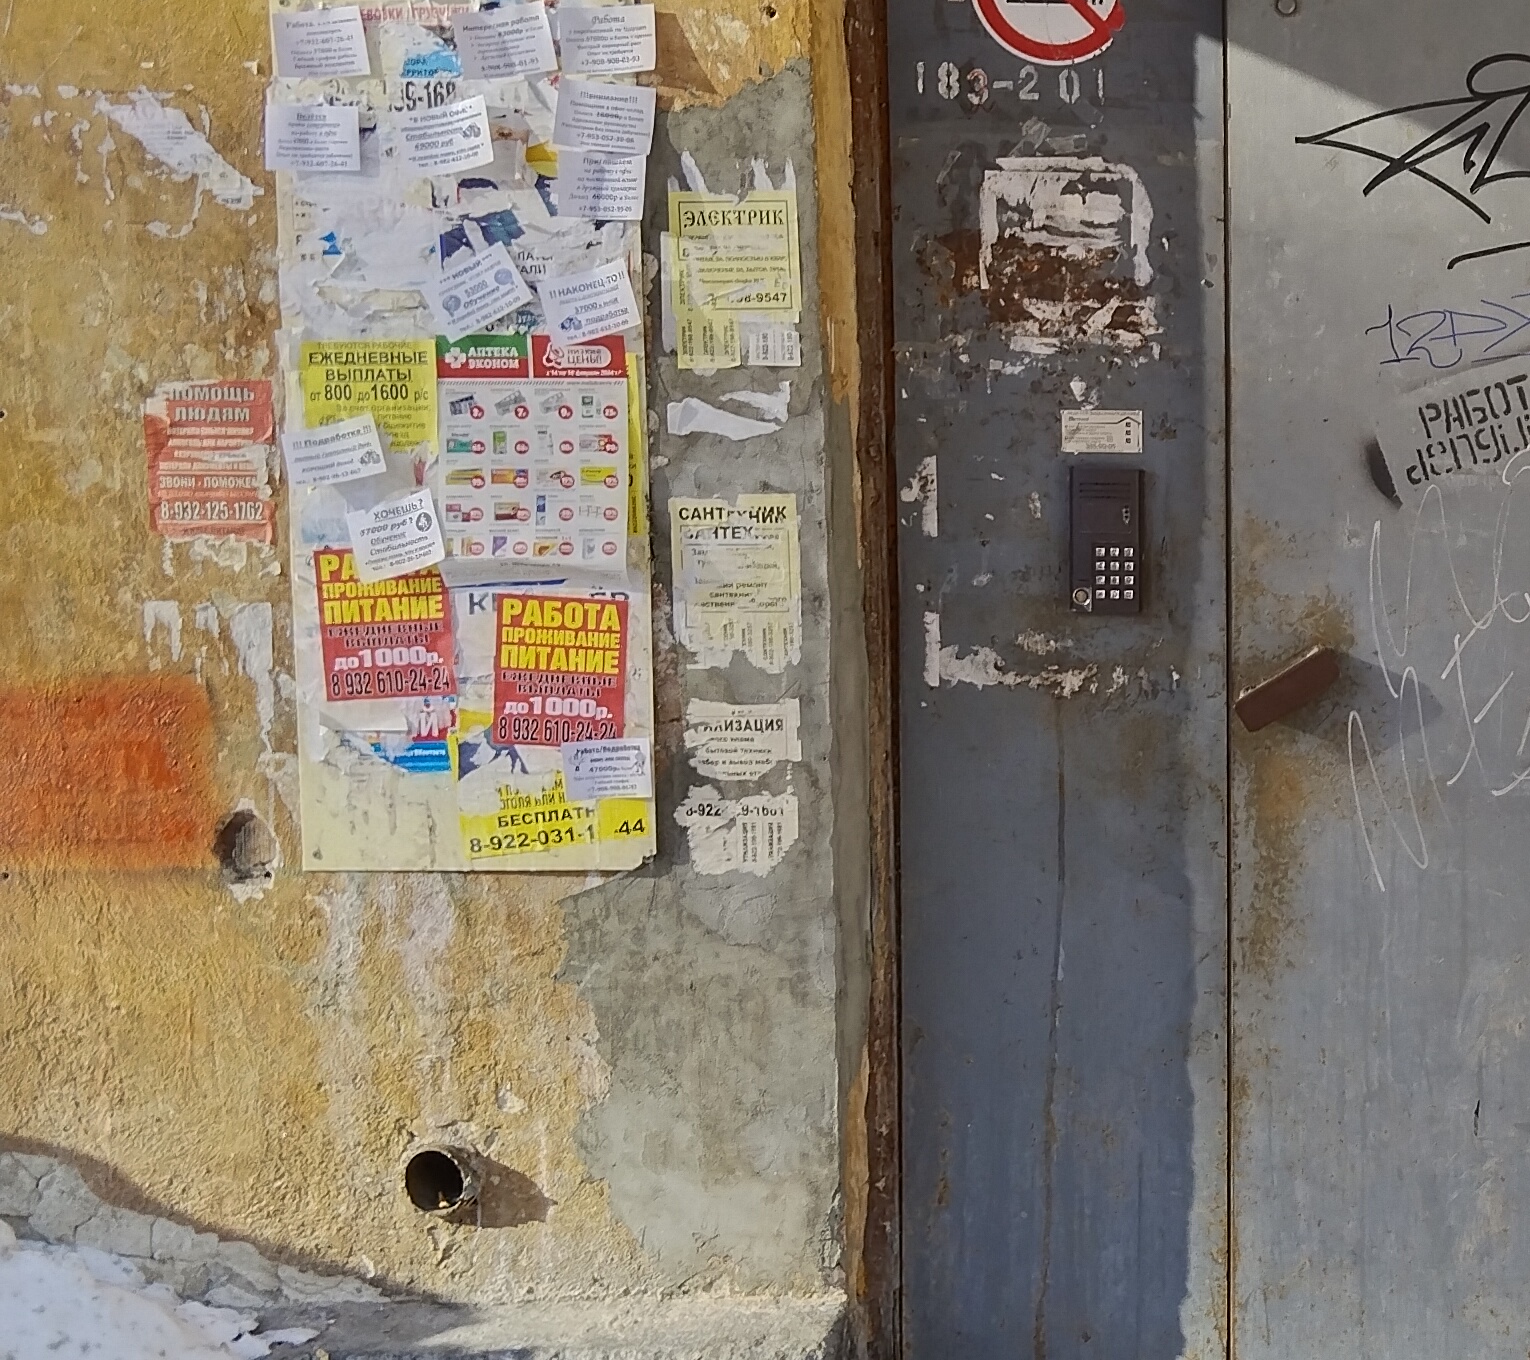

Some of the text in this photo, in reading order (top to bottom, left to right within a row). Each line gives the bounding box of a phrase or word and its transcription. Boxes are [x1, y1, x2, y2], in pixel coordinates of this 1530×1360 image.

[683, 209, 785, 229] ЭЛЕКТРИК
[308, 351, 428, 365] ЕЖЕДНЕВНЫЕ
[468, 346, 519, 358] АПТЕКА
[325, 368, 412, 382] ВЫПЛАТЫ
[309, 392, 322, 401] от
[324, 384, 352, 401] 800
[357, 393, 370, 403] до
[371, 383, 409, 400] 1600
[174, 406, 250, 423] ЛЮДЯМ
[159, 476, 196, 489] ЗВОНИ
[322, 576, 442, 600] ПРОЖИВАНИЕ
[323, 594, 445, 625] ПИТАНИЕ
[502, 597, 621, 631] РАБОТА
[501, 626, 621, 649] ПРОЖИВАНИЕ
[333, 645, 444, 671] до 1000р.
[500, 643, 620, 675] ПИТАНИЕ
[331, 667, 451, 697] 8 932 610-24-24
[503, 696, 614, 721] до 1000р.
[499, 715, 617, 744] 8 932 610-24-24
[497, 806, 595, 829] БЕСПЛАТН
